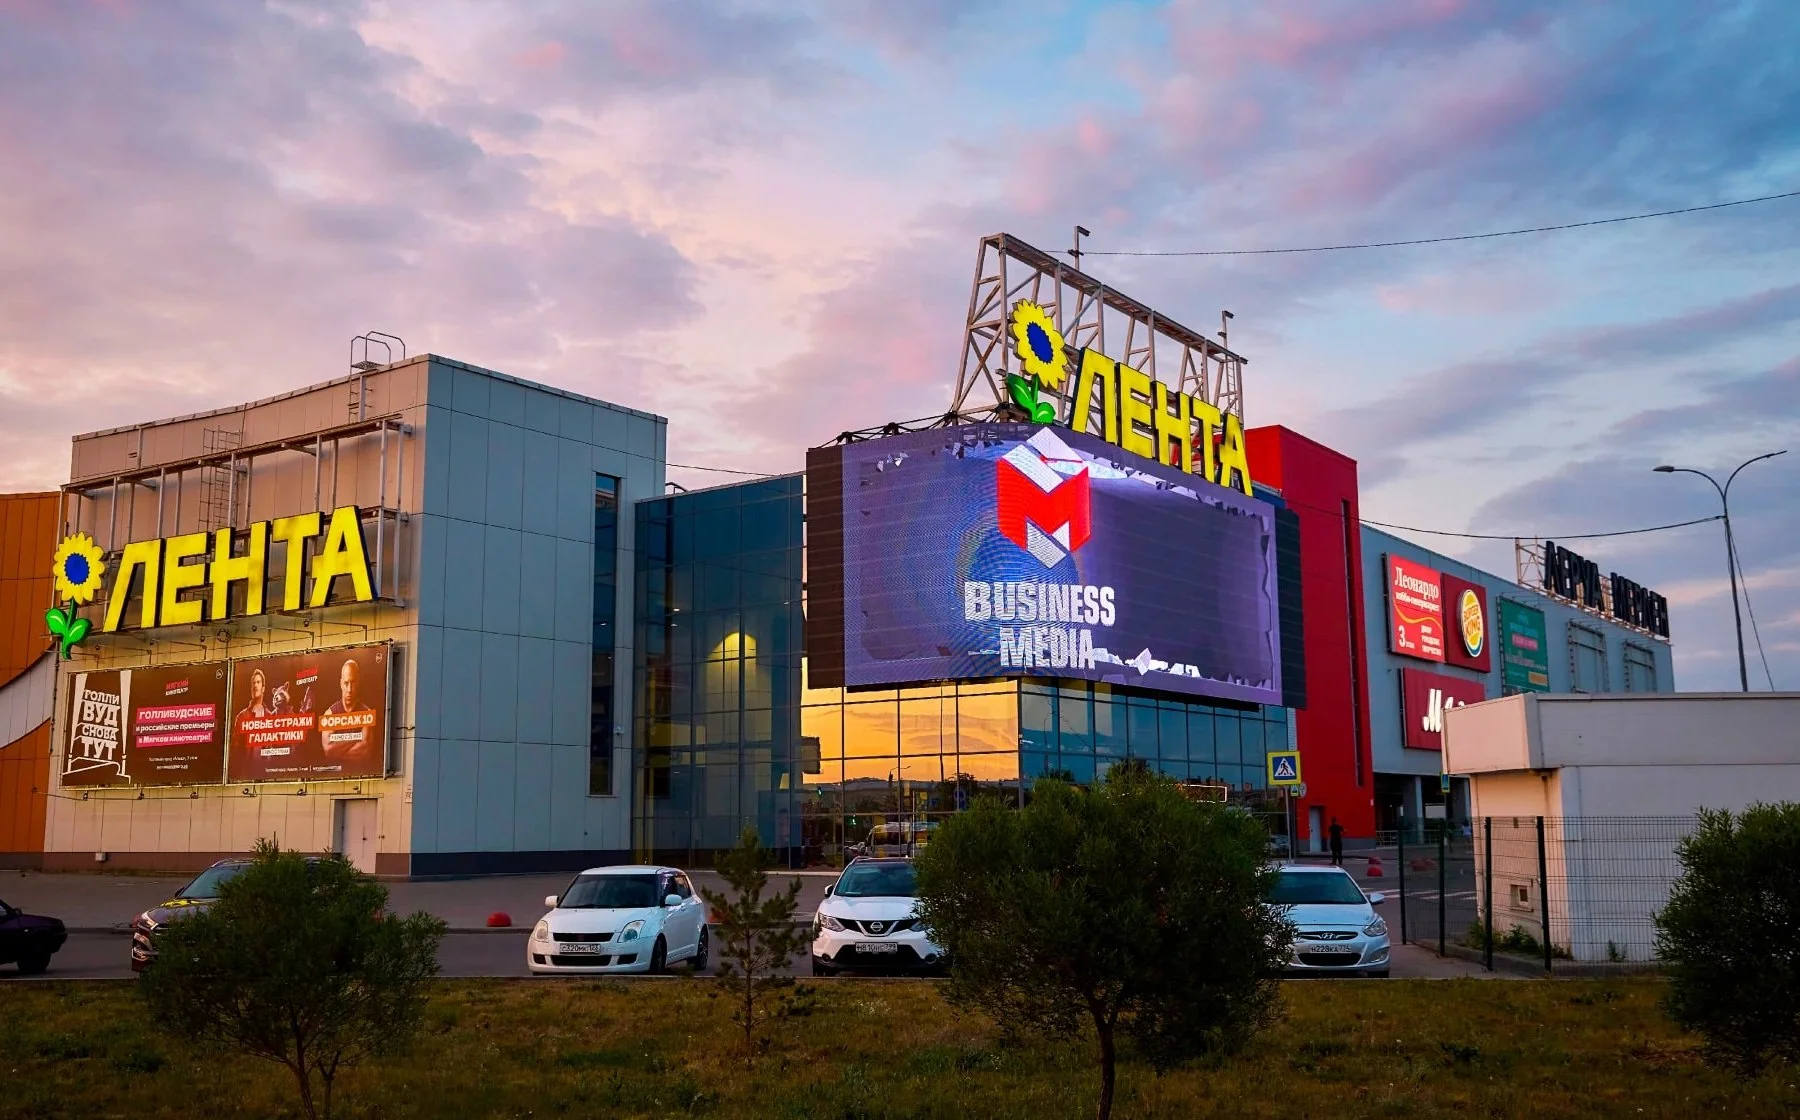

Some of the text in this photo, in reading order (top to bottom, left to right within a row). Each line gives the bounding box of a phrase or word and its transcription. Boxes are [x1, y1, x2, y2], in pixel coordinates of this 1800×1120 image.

[1070, 347, 1253, 497] ЛЕНТА
[102, 505, 377, 632] ЛЕНТА
[1395, 566, 1439, 600] Леонардо
[964, 581, 1116, 627] BUSINESS
[1000, 627, 1095, 670] MEDIA
[84, 689, 120, 705] ГОЛЛИ
[82, 700, 121, 728] ВУД
[139, 707, 213, 720] ГОЛЛИВУДСКИЕ
[241, 716, 313, 731] НОВЫЕ СТРАЖИ
[320, 714, 374, 727] ФОРСАЖ 10
[82, 724, 119, 741] СНОВА
[140, 724, 179, 733] российские
[180, 722, 215, 731] премьеры
[248, 730, 304, 744] ГАЛАКТИКИ
[81, 737, 119, 760] ТУТ
